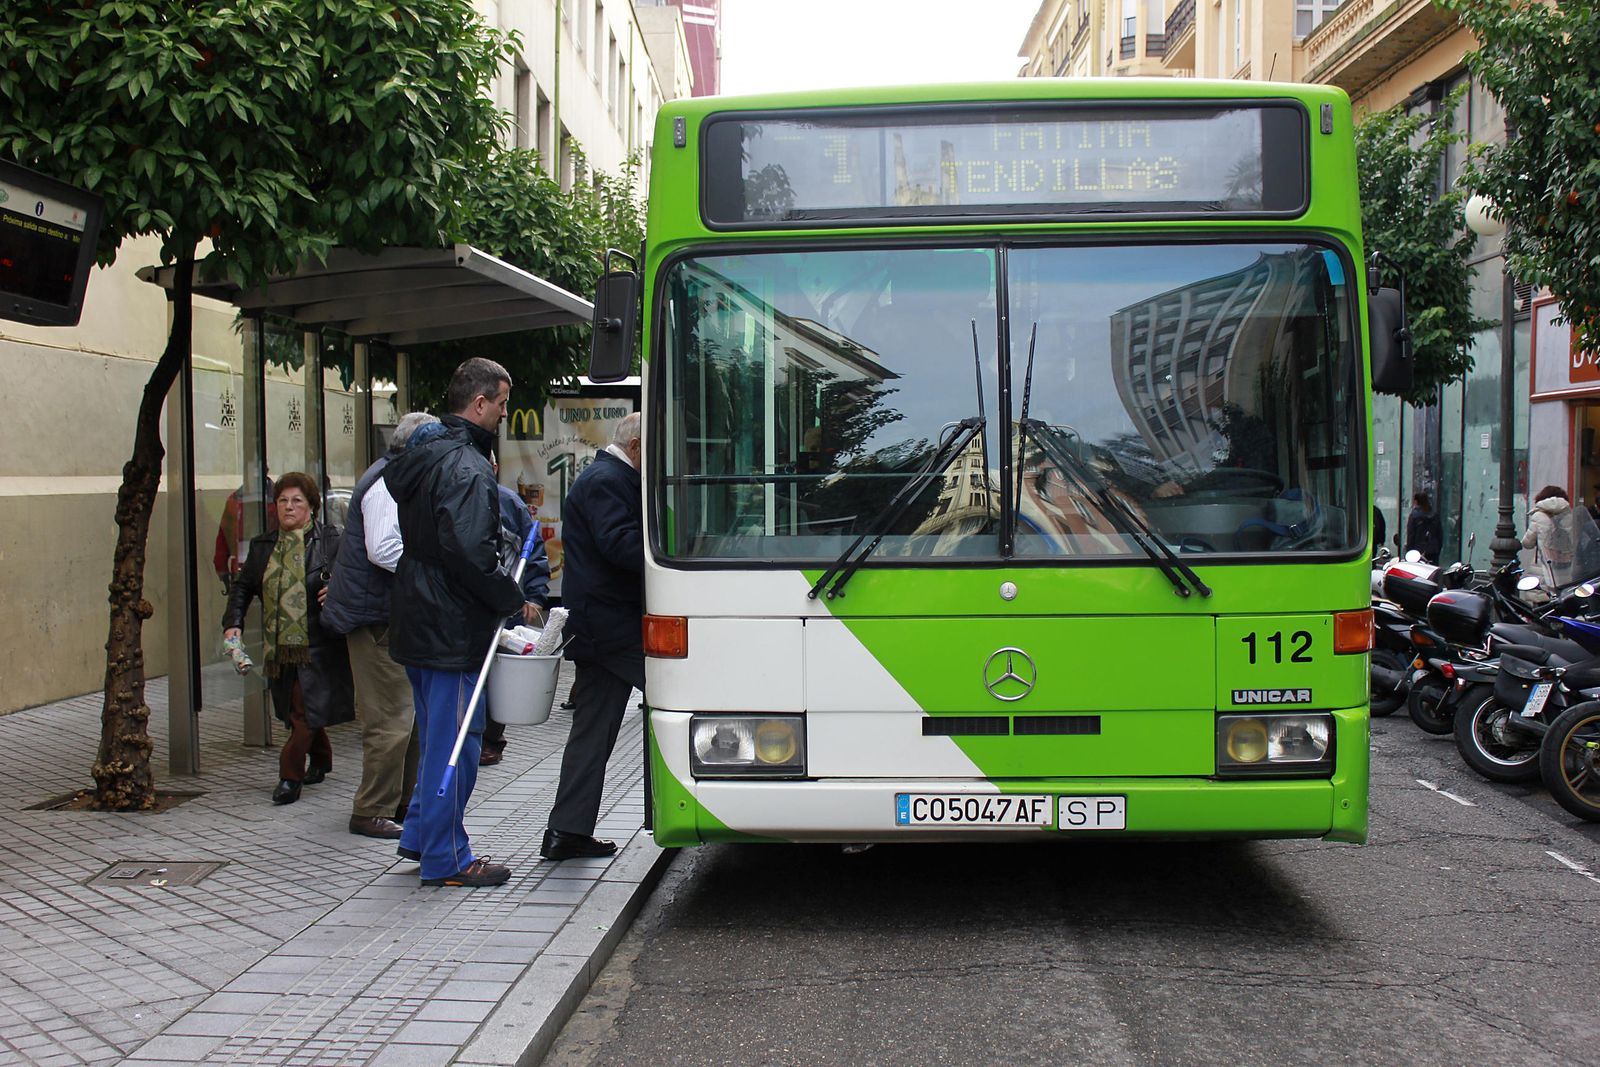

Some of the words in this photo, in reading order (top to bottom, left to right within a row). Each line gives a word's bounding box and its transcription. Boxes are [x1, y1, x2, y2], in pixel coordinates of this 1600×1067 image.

[940, 156, 1180, 194] TENDILLAS
[559, 407, 590, 424] UNO
[603, 406, 627, 420] UNO
[1241, 630, 1313, 664] 112
[1234, 690, 1311, 703] UNICAR
